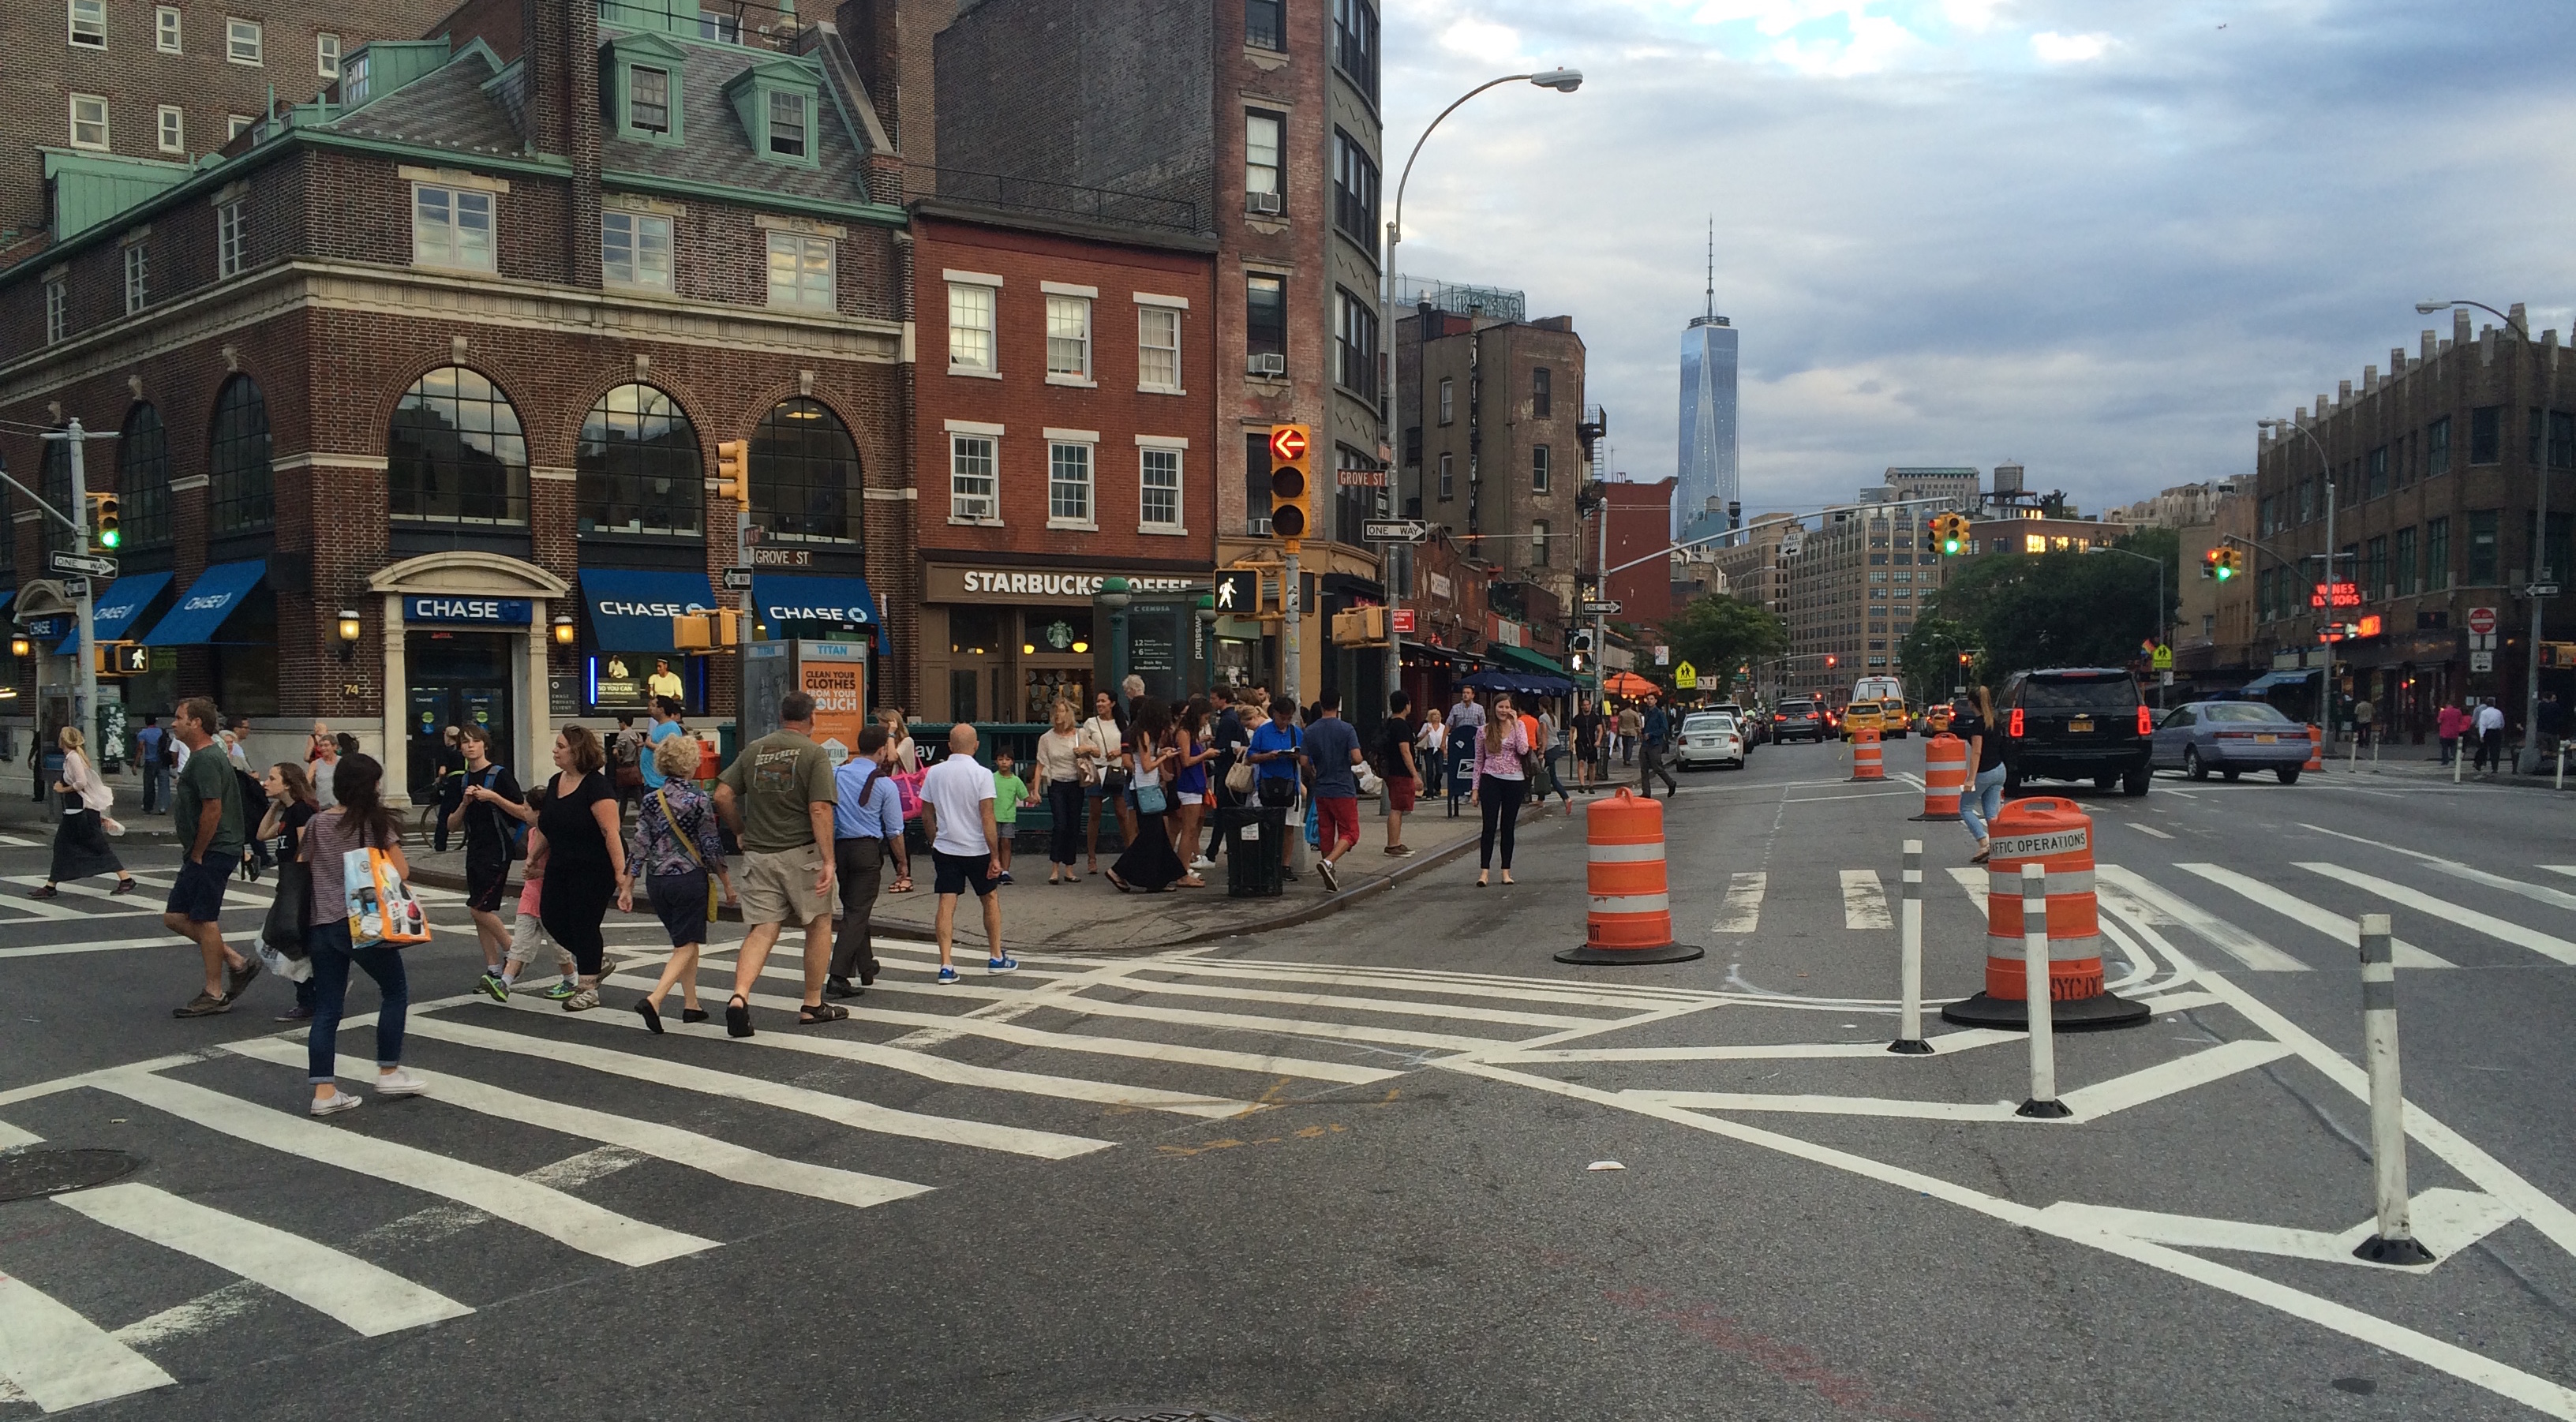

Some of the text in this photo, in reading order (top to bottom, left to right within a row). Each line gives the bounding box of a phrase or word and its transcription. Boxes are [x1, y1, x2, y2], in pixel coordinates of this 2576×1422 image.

[1341, 472, 1383, 485] GROVE ST
[1368, 526, 1419, 535] ONE WAY
[57, 557, 109, 571] ONE WAY
[755, 550, 809, 565] GROVE ST
[964, 571, 1193, 596] STARBUCKS OFFEE
[2316, 584, 2355, 594] WNES
[184, 596, 217, 610] CHASE
[2312, 594, 2360, 606] LIUORS
[416, 600, 500, 619] CHASE
[600, 601, 681, 617] CHASE
[769, 606, 844, 621] CHASE
[1195, 612, 1204, 660] ewsstand
[757, 646, 775, 656] TITAN
[816, 645, 848, 656] TITAN
[344, 684, 358, 695] 74
[806, 679, 856, 690] CLOTHES
[815, 698, 857, 711] OUCH
[915, 745, 936, 761] ay
[754, 754, 774, 766] DEEP
[2017, 832, 2085, 852] OPERATIONS
